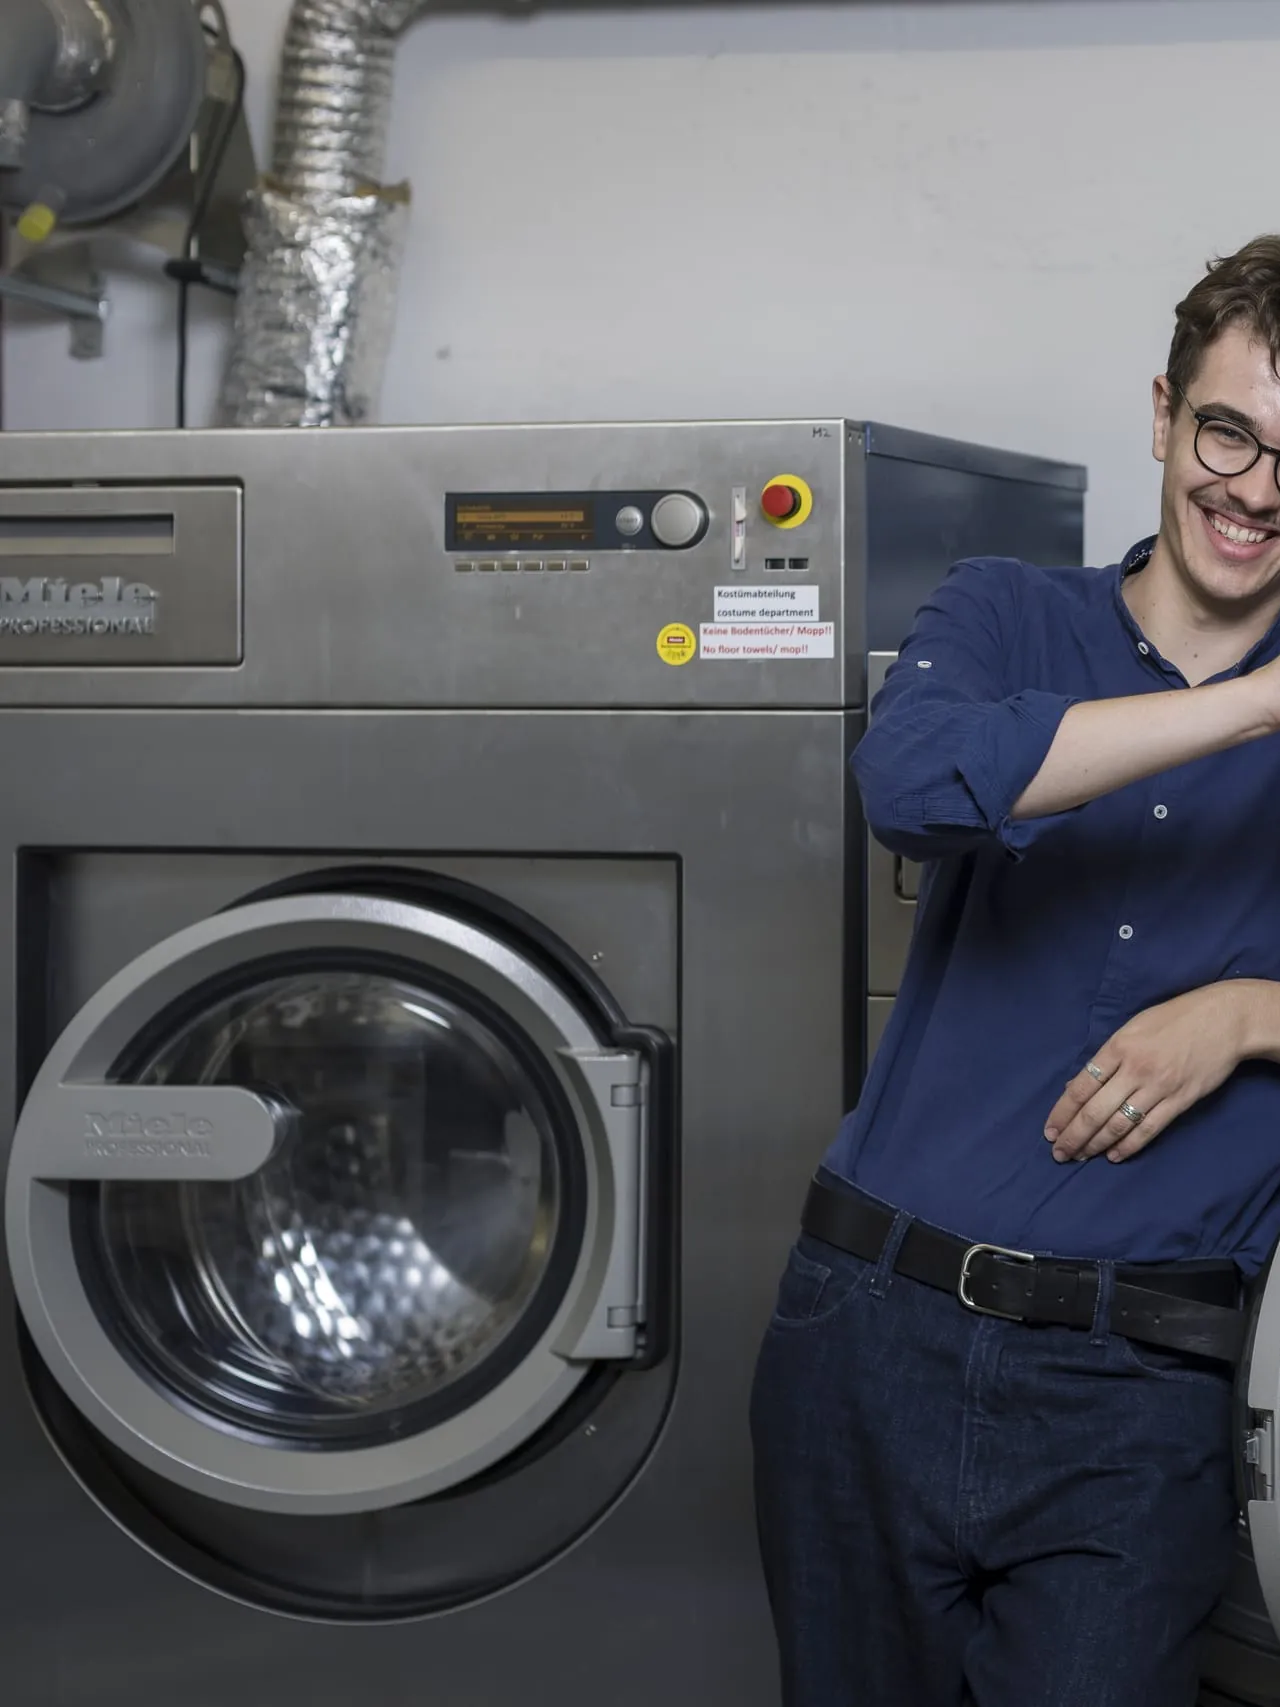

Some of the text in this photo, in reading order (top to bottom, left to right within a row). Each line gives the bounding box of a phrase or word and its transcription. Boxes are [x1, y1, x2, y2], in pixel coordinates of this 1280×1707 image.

[812, 427, 831, 438] M2
[0, 576, 157, 605] Miele
[717, 589, 796, 600] Kostümabteilung
[717, 607, 814, 618] costume department
[0, 616, 154, 635] PROFESSIONAL
[703, 626, 832, 636] Keine Bodentücher/ Mopp!!
[703, 645, 808, 654] No floor towels/ mop!!
[83, 1111, 214, 1137] Miele
